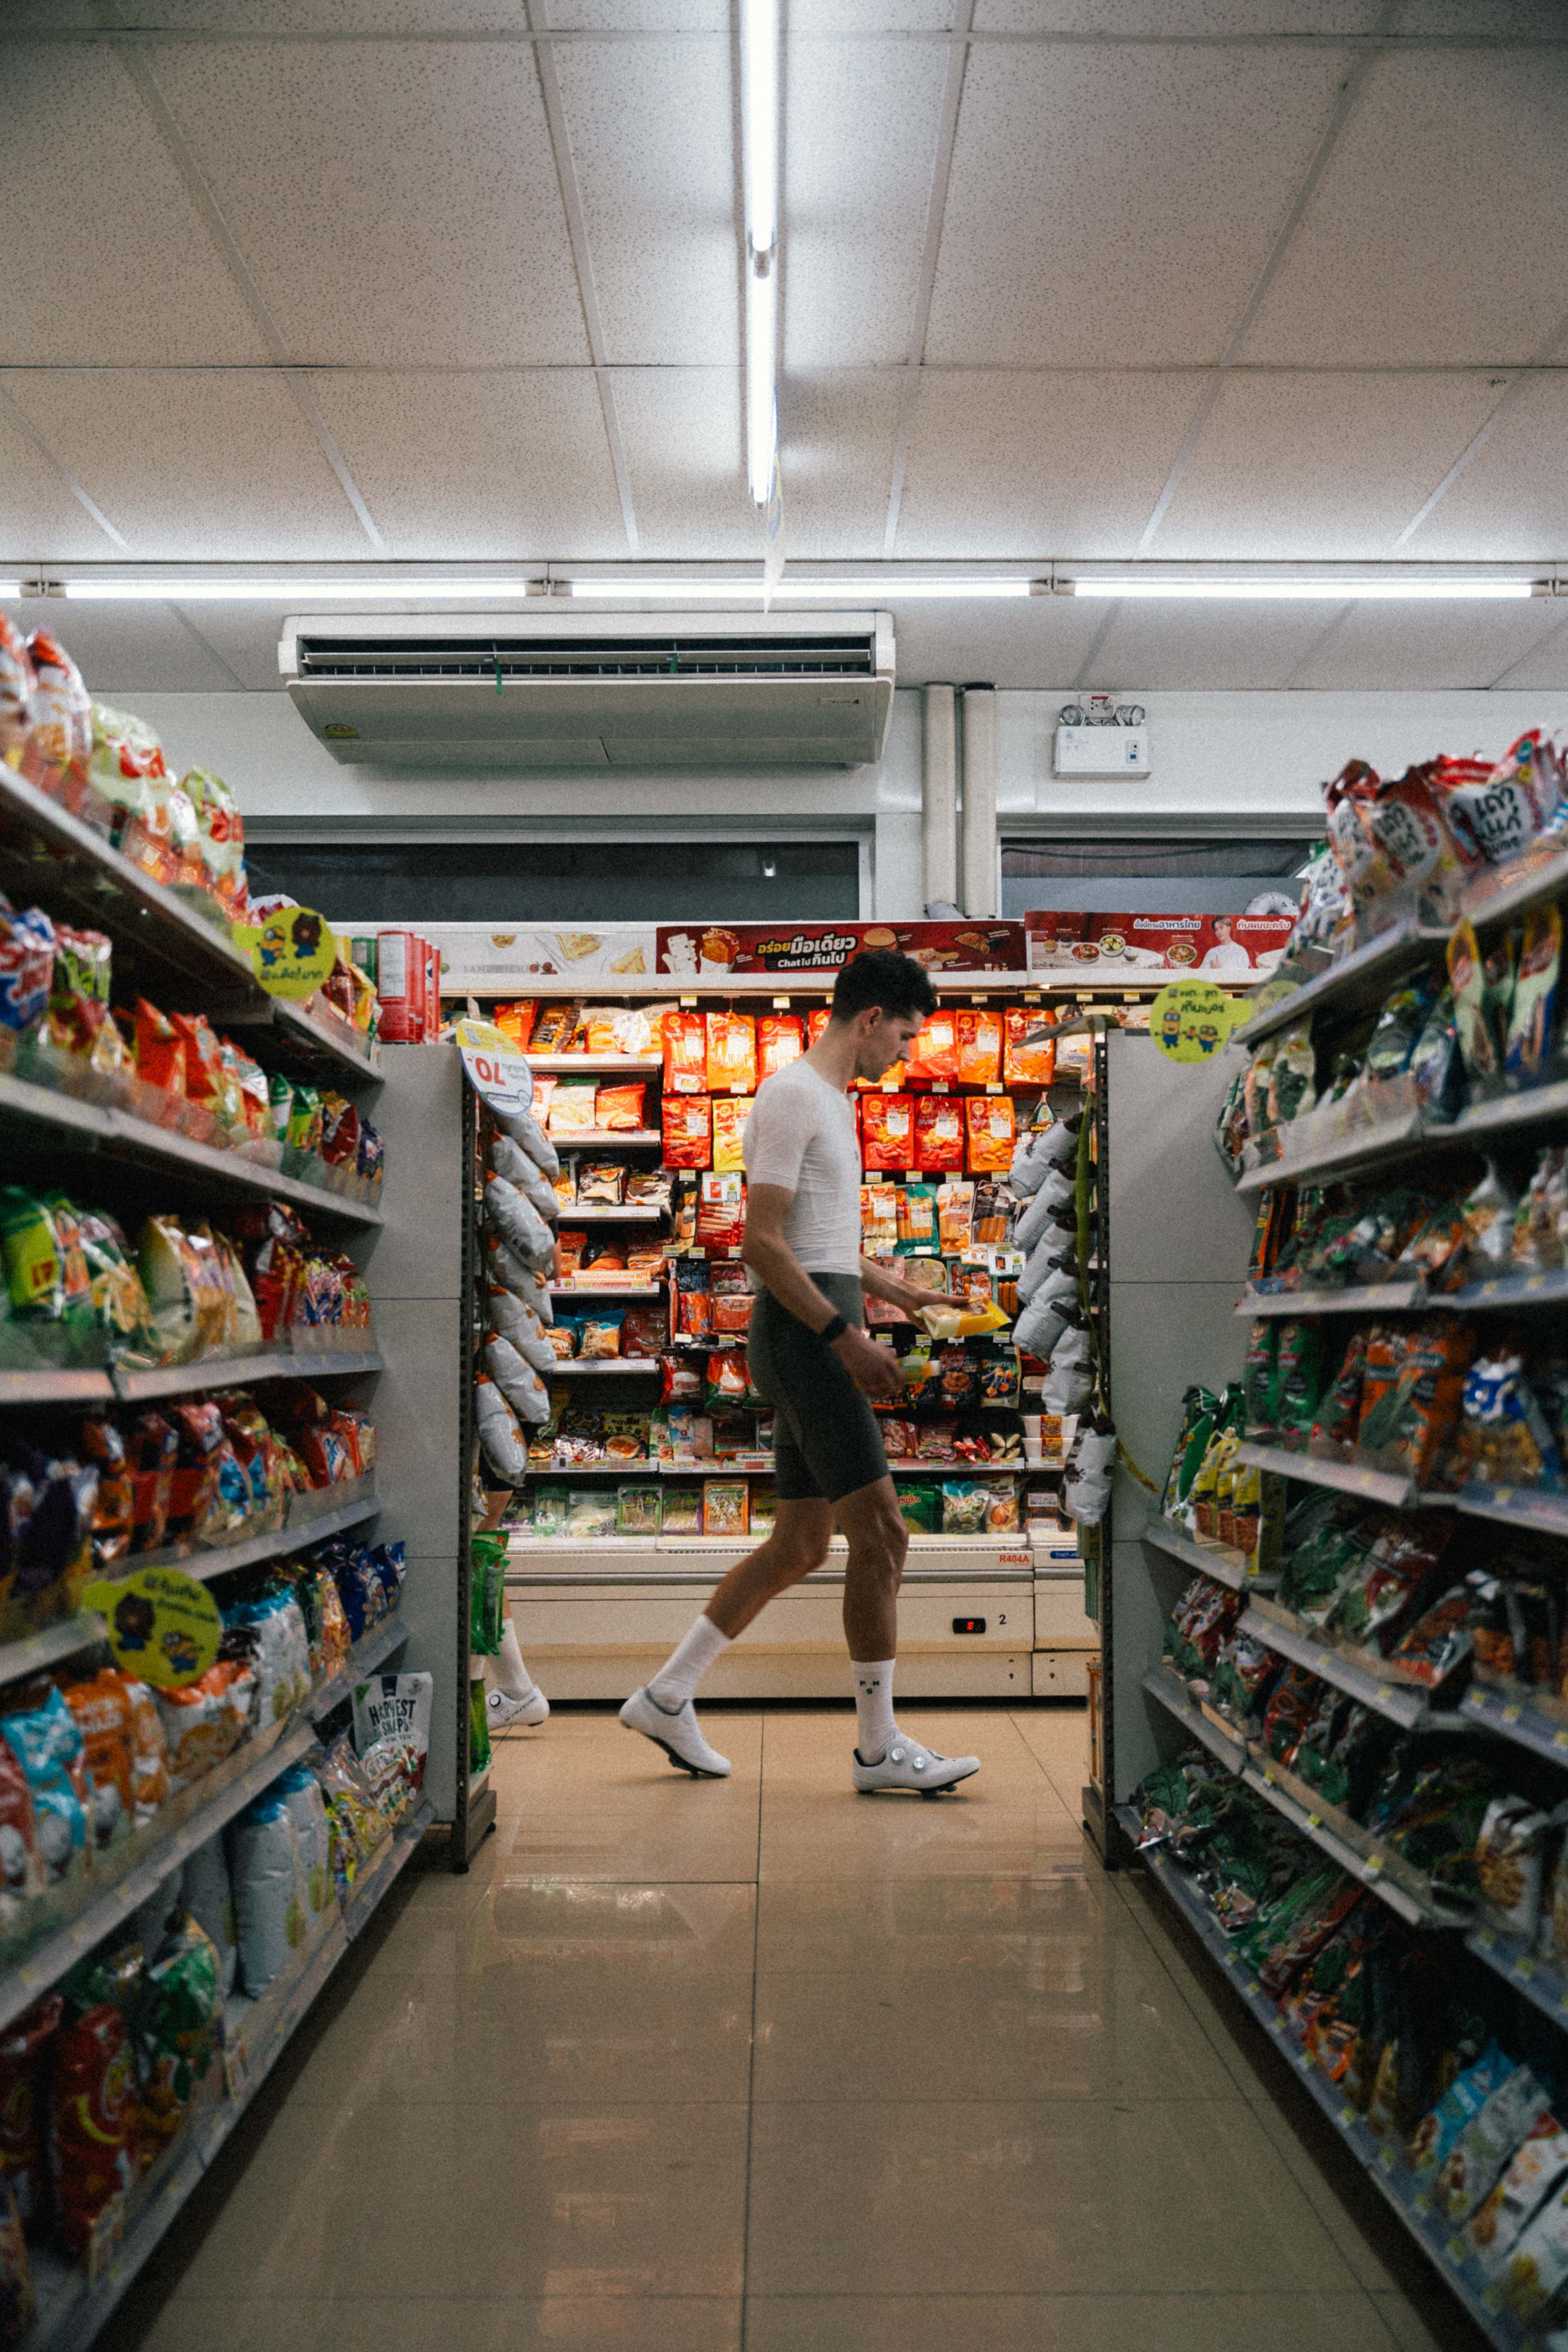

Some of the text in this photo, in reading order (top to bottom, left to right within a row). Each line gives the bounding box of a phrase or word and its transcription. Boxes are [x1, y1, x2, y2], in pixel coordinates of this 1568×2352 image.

[758, 933, 856, 955] อร่อยมือเดียว
[999, 1554, 1030, 1563] R404A
[999, 1614, 1007, 1625] 2
[368, 1699, 416, 1726] HARVEST
[381, 1718, 410, 1735] SNAPS
